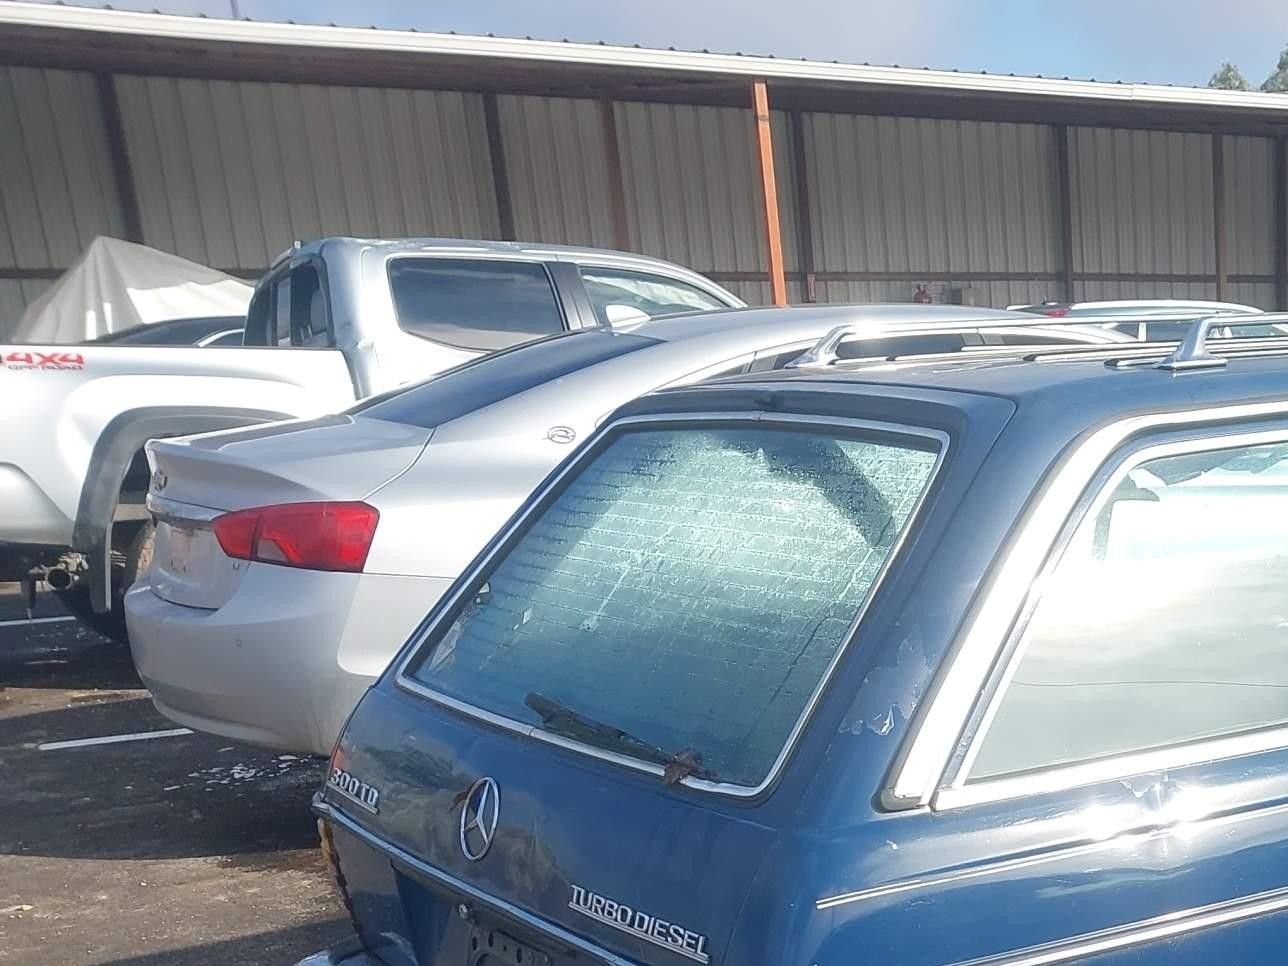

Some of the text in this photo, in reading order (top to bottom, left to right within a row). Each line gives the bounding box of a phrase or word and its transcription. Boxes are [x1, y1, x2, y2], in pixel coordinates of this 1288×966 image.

[330, 767, 379, 807] 300 TD
[570, 884, 709, 959] TURBO DIESEL
